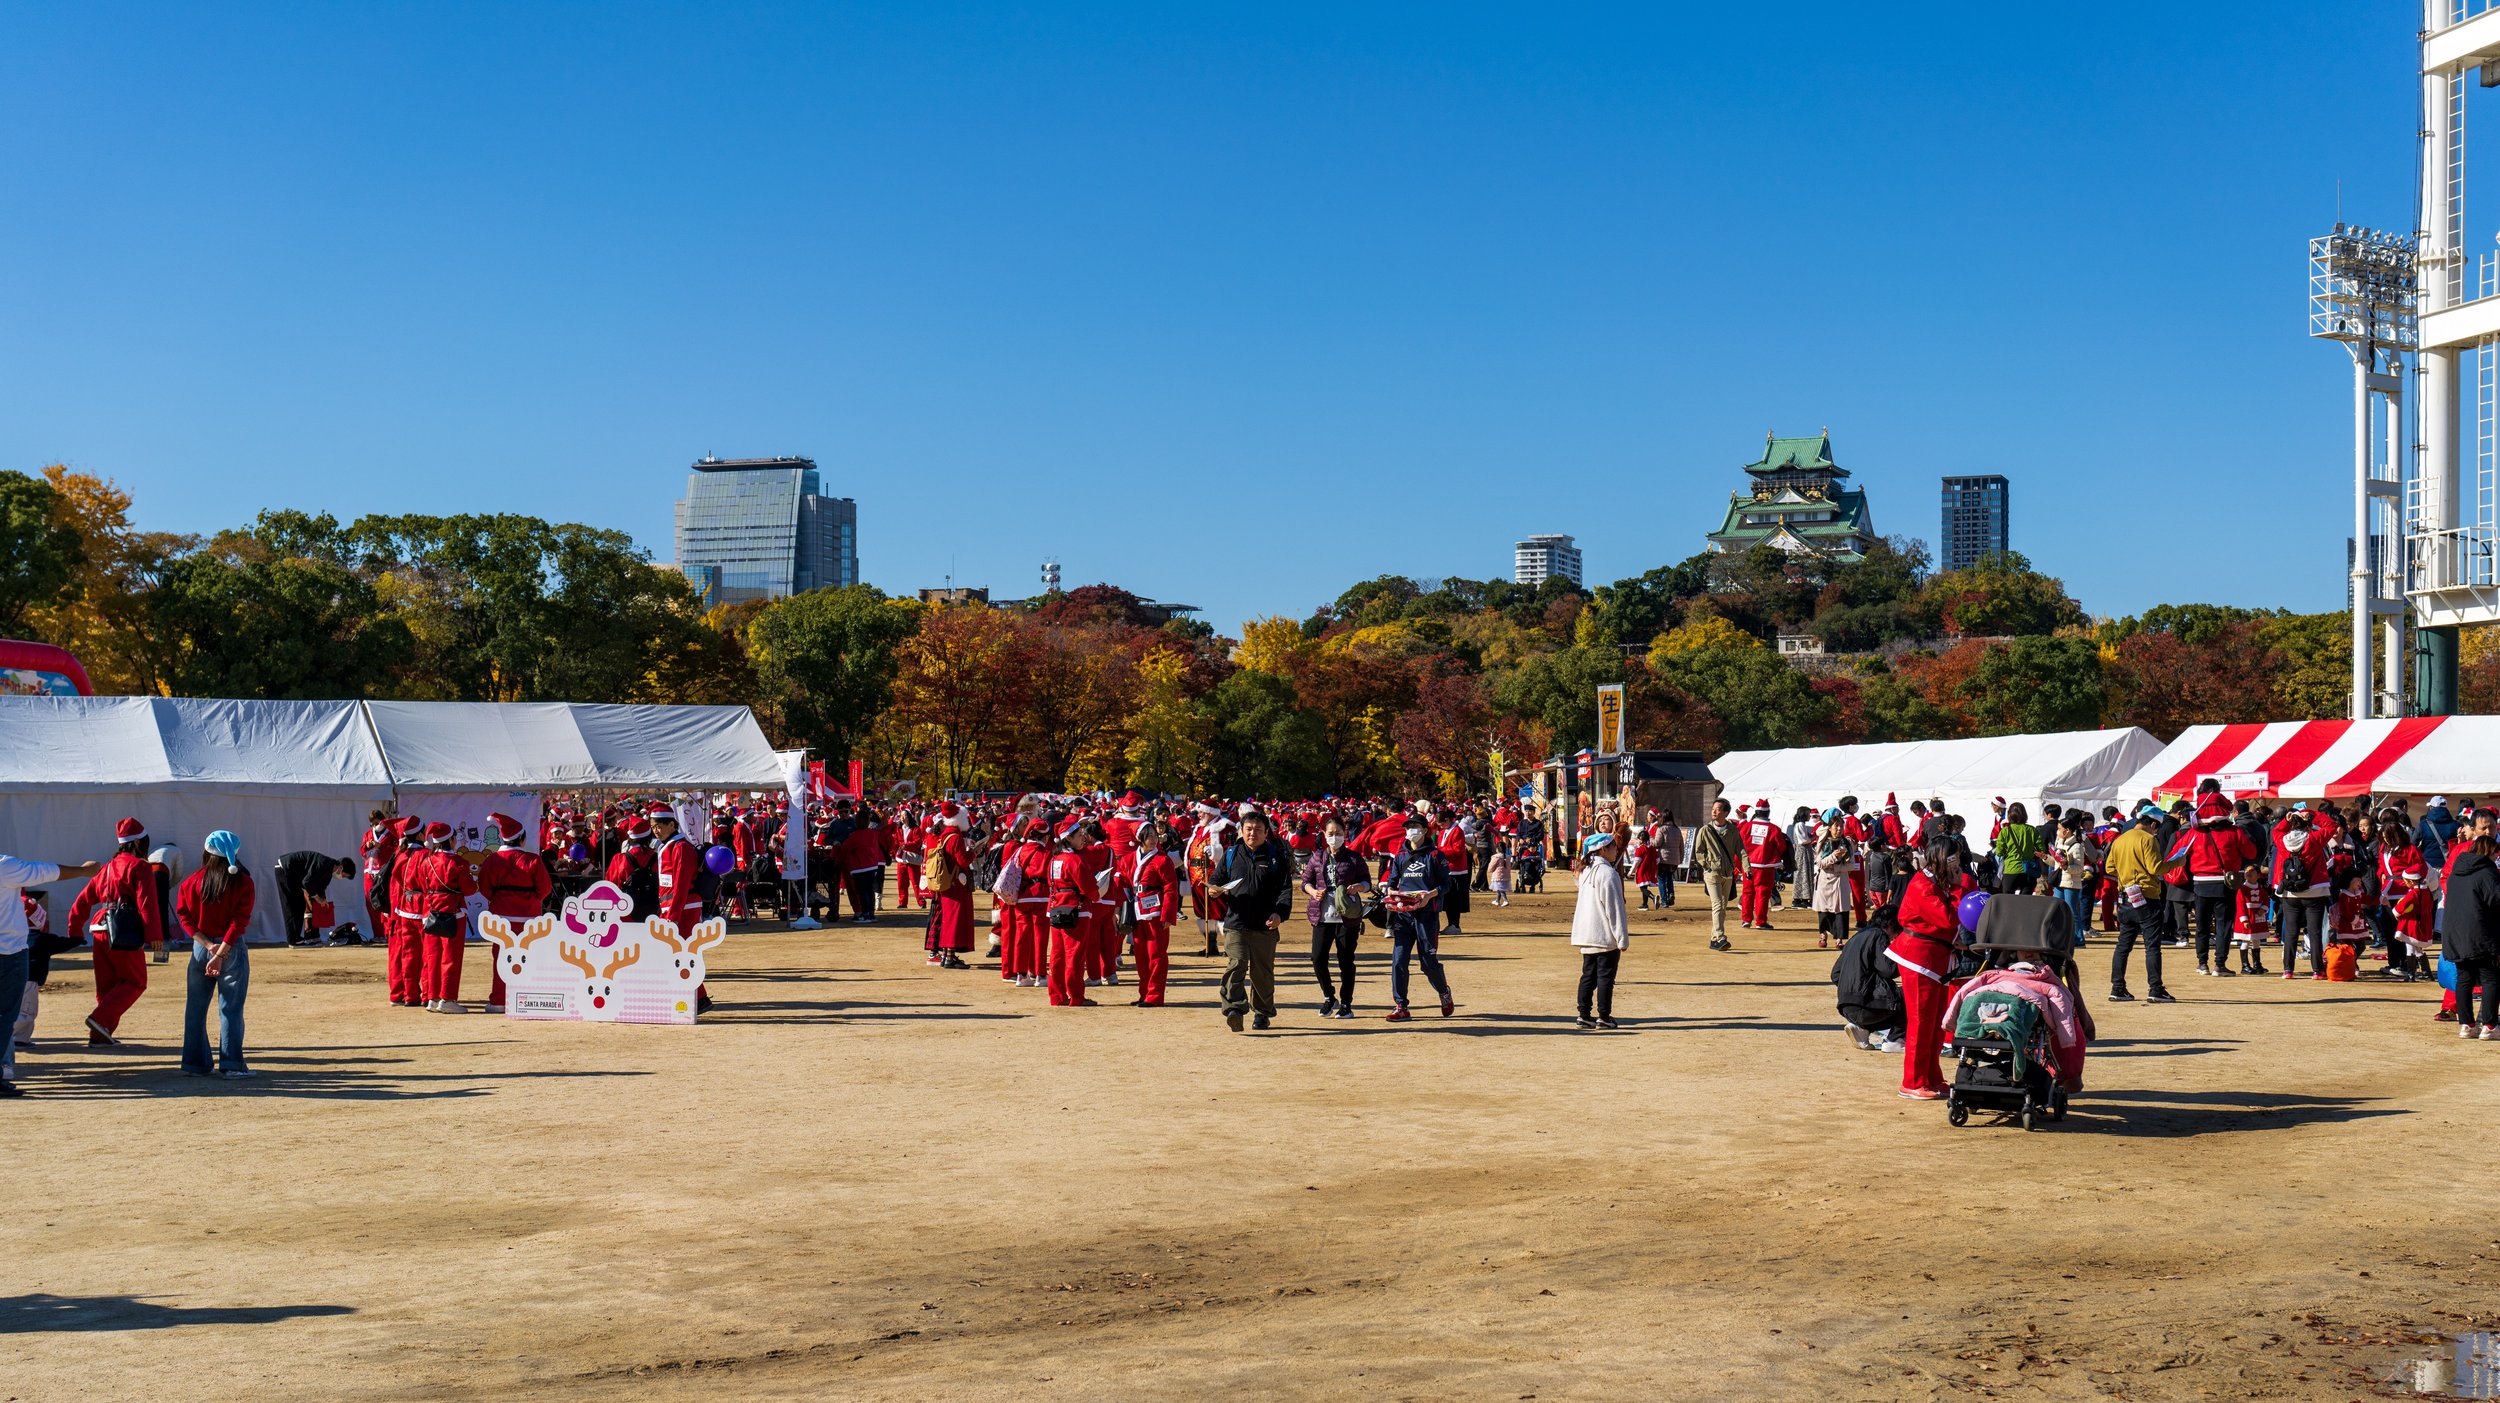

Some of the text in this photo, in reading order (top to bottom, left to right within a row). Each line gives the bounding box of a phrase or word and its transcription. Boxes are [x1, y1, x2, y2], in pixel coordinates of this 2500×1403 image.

[1602, 694, 1619, 753] 生ビール
[540, 1001, 557, 1009] PARADE
